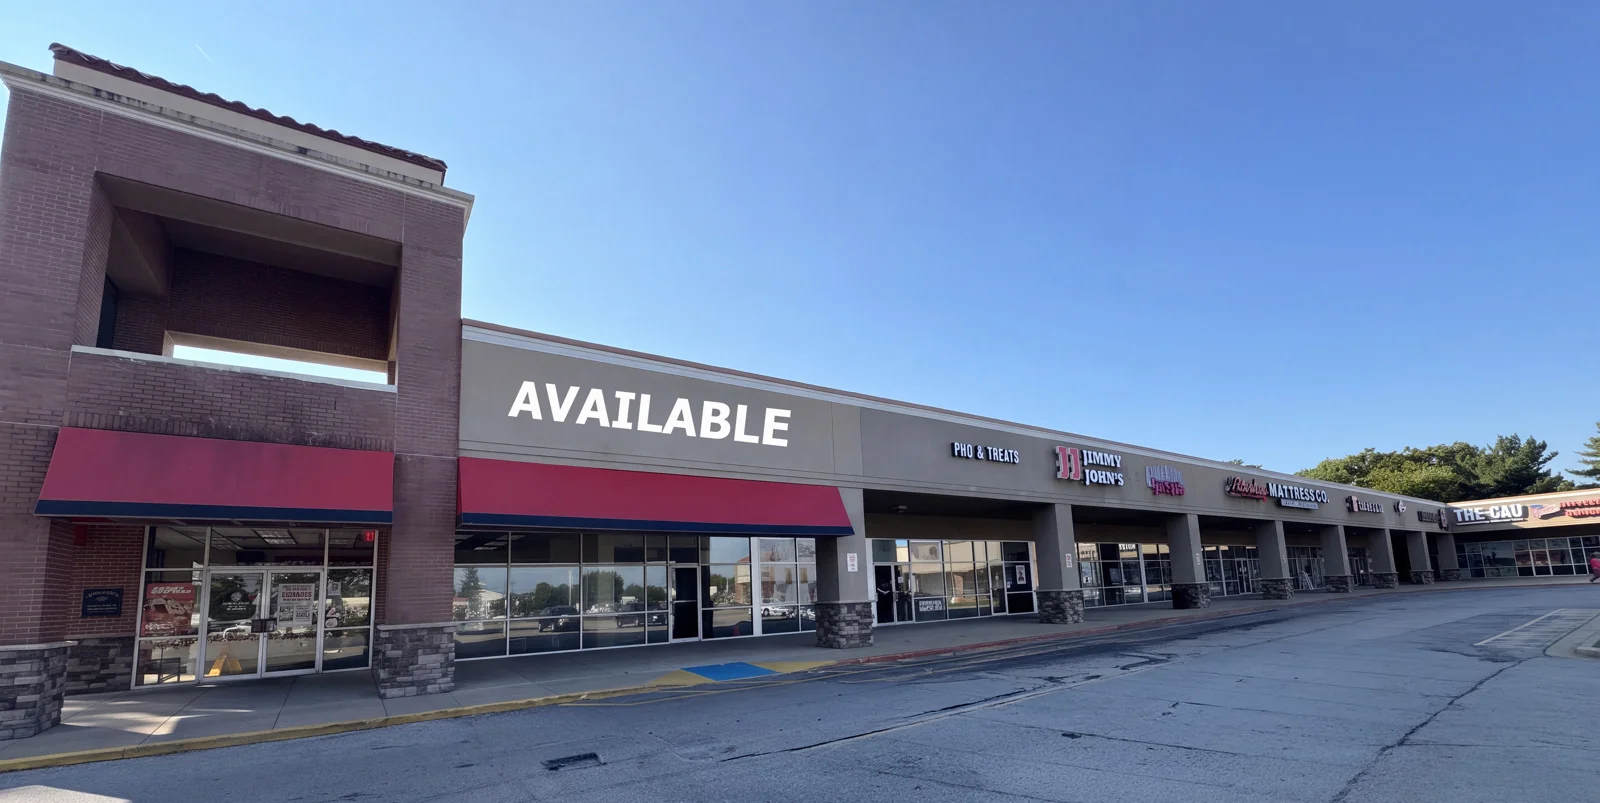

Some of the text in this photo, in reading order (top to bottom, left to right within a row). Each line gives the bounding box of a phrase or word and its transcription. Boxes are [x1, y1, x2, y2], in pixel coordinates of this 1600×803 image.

[508, 380, 792, 447] AVAILABLE
[953, 442, 1020, 464] PHO & TREATS
[1082, 449, 1122, 468] JIMMY
[1084, 469, 1124, 486] JOHN'S
[1268, 482, 1315, 502] MATTRESS
[1453, 507, 1486, 522] THE
